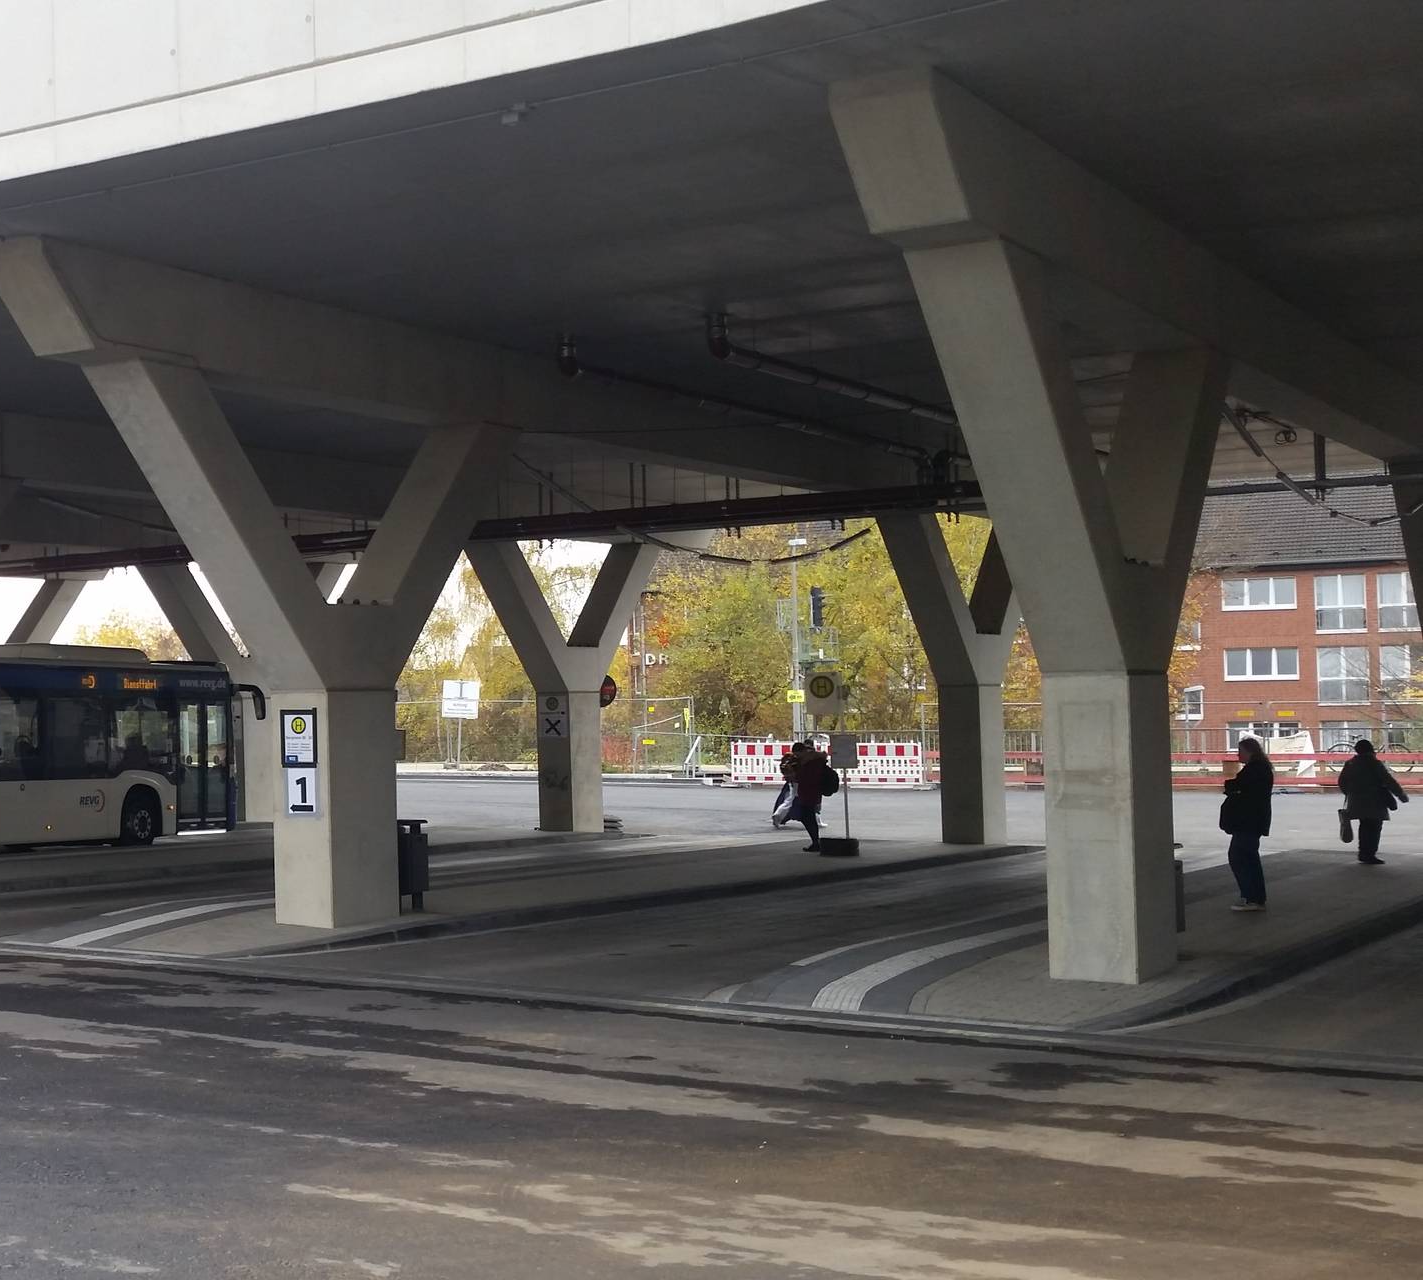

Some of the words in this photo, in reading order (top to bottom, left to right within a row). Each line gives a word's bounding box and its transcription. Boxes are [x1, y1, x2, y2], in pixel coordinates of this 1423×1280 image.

[179, 677, 227, 690] www.revg.de
[295, 777, 307, 804] 1
[80, 795, 100, 806] REVG
